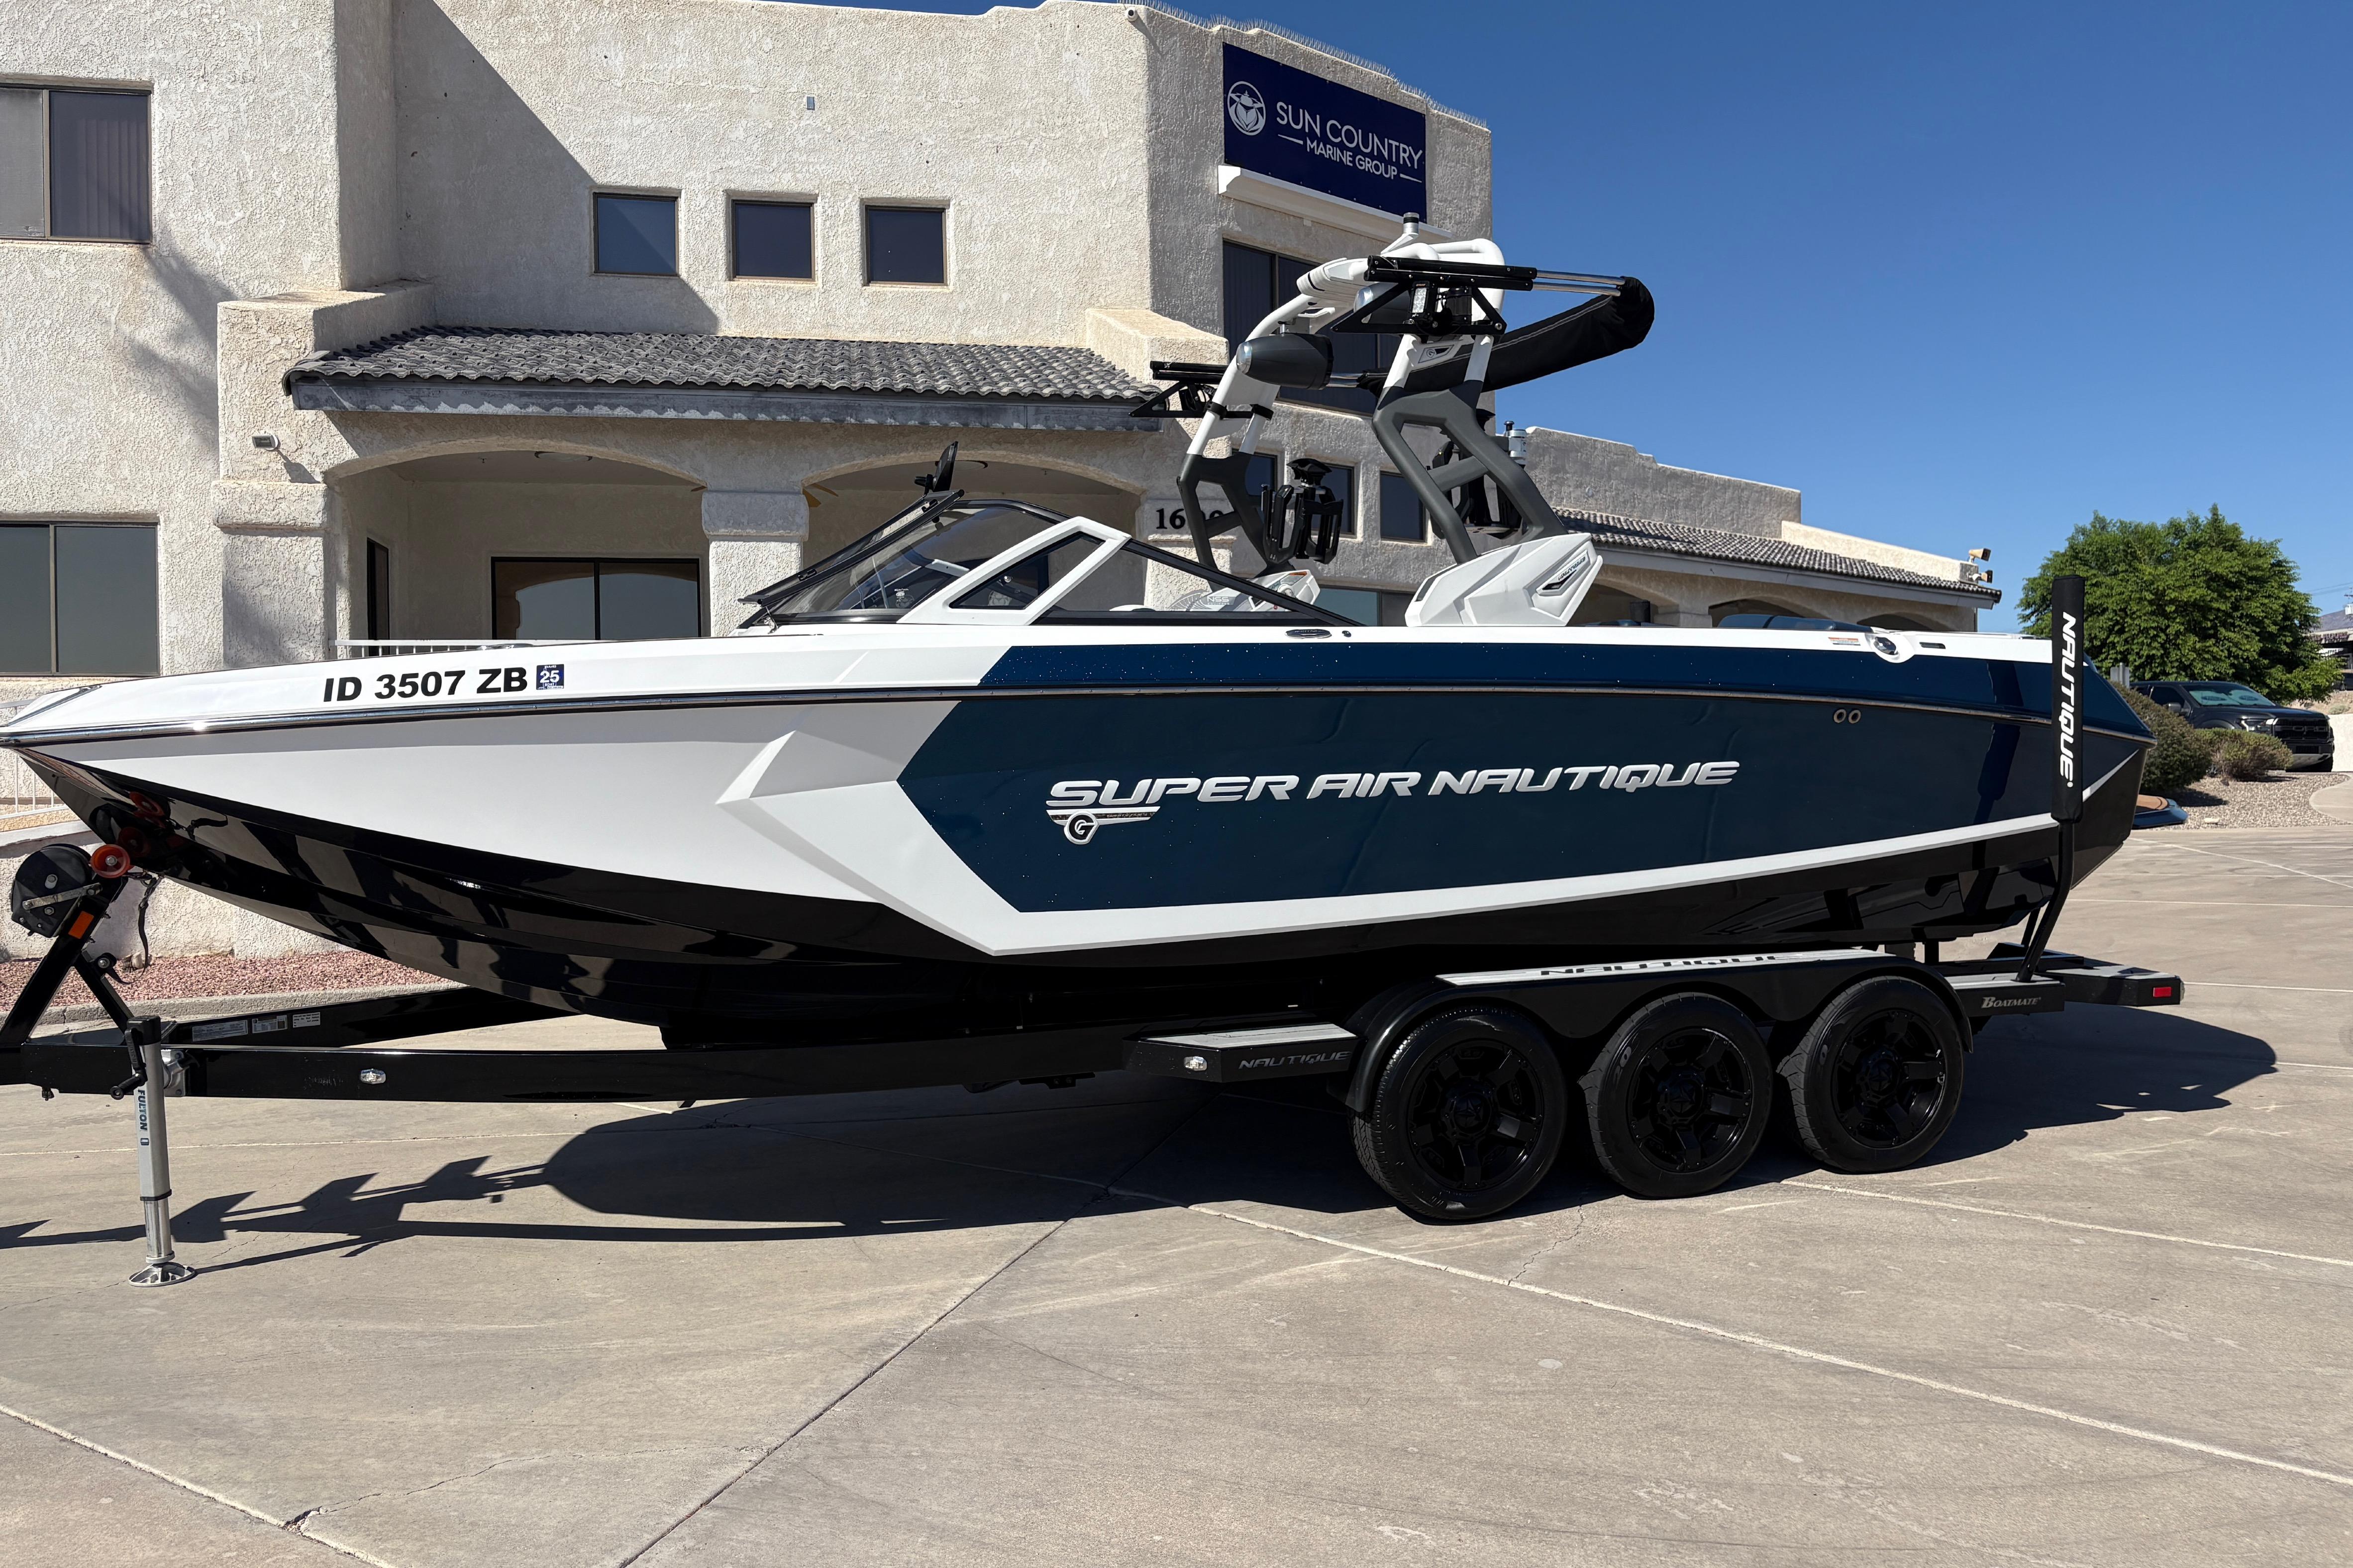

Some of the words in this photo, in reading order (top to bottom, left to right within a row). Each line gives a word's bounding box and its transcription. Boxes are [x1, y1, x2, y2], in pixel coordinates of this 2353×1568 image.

[1277, 101, 1320, 137] SUN
[1327, 120, 1423, 169] COUNTRY
[1307, 137, 1353, 166] MARINE
[1355, 155, 1397, 180] GROUP
[1156, 508, 1225, 529] 16
[323, 677, 362, 702] ID
[374, 670, 466, 699] 3507
[476, 667, 527, 694] ZB
[539, 670, 560, 683] 25
[2058, 611, 2076, 782] NAUTIQUE
[1046, 776, 1300, 807] SUPER
[1306, 772, 1422, 799] AIR
[1428, 761, 1740, 795] NAUTIQUE
[1981, 996, 2039, 1009] BOATMATE
[1238, 1051, 1351, 1070] NAUTIQUE
[138, 1089, 148, 1131] FULTON
